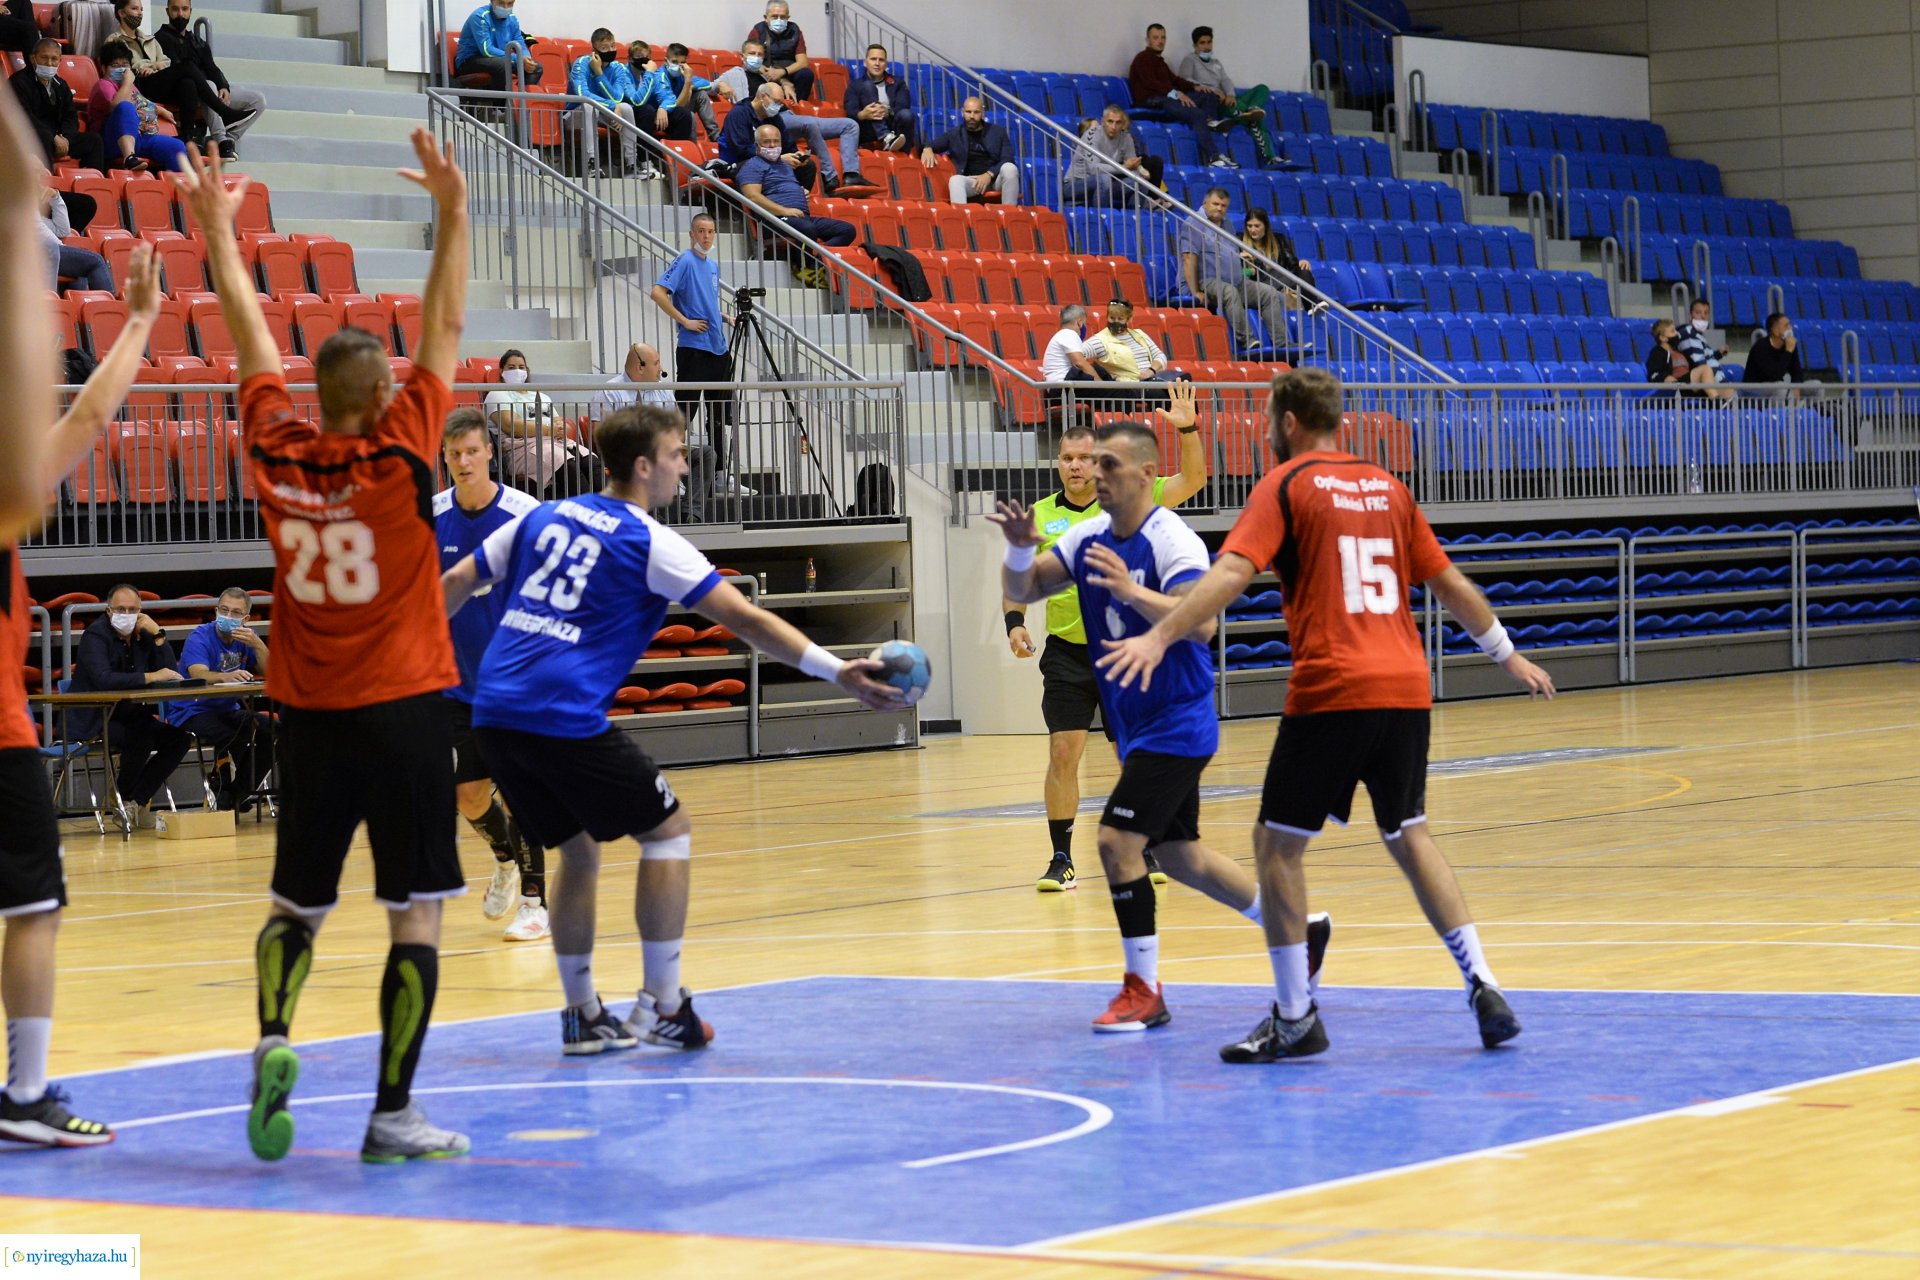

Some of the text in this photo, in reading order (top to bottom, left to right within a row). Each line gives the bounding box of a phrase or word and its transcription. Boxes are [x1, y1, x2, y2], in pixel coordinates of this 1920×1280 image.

[1313, 475, 1360, 493] Optimum
[1365, 496, 1390, 511] FKC
[280, 518, 380, 605] 28
[519, 522, 602, 612] 23
[1338, 535, 1399, 614] 15
[1112, 806, 1135, 819] JAKO
